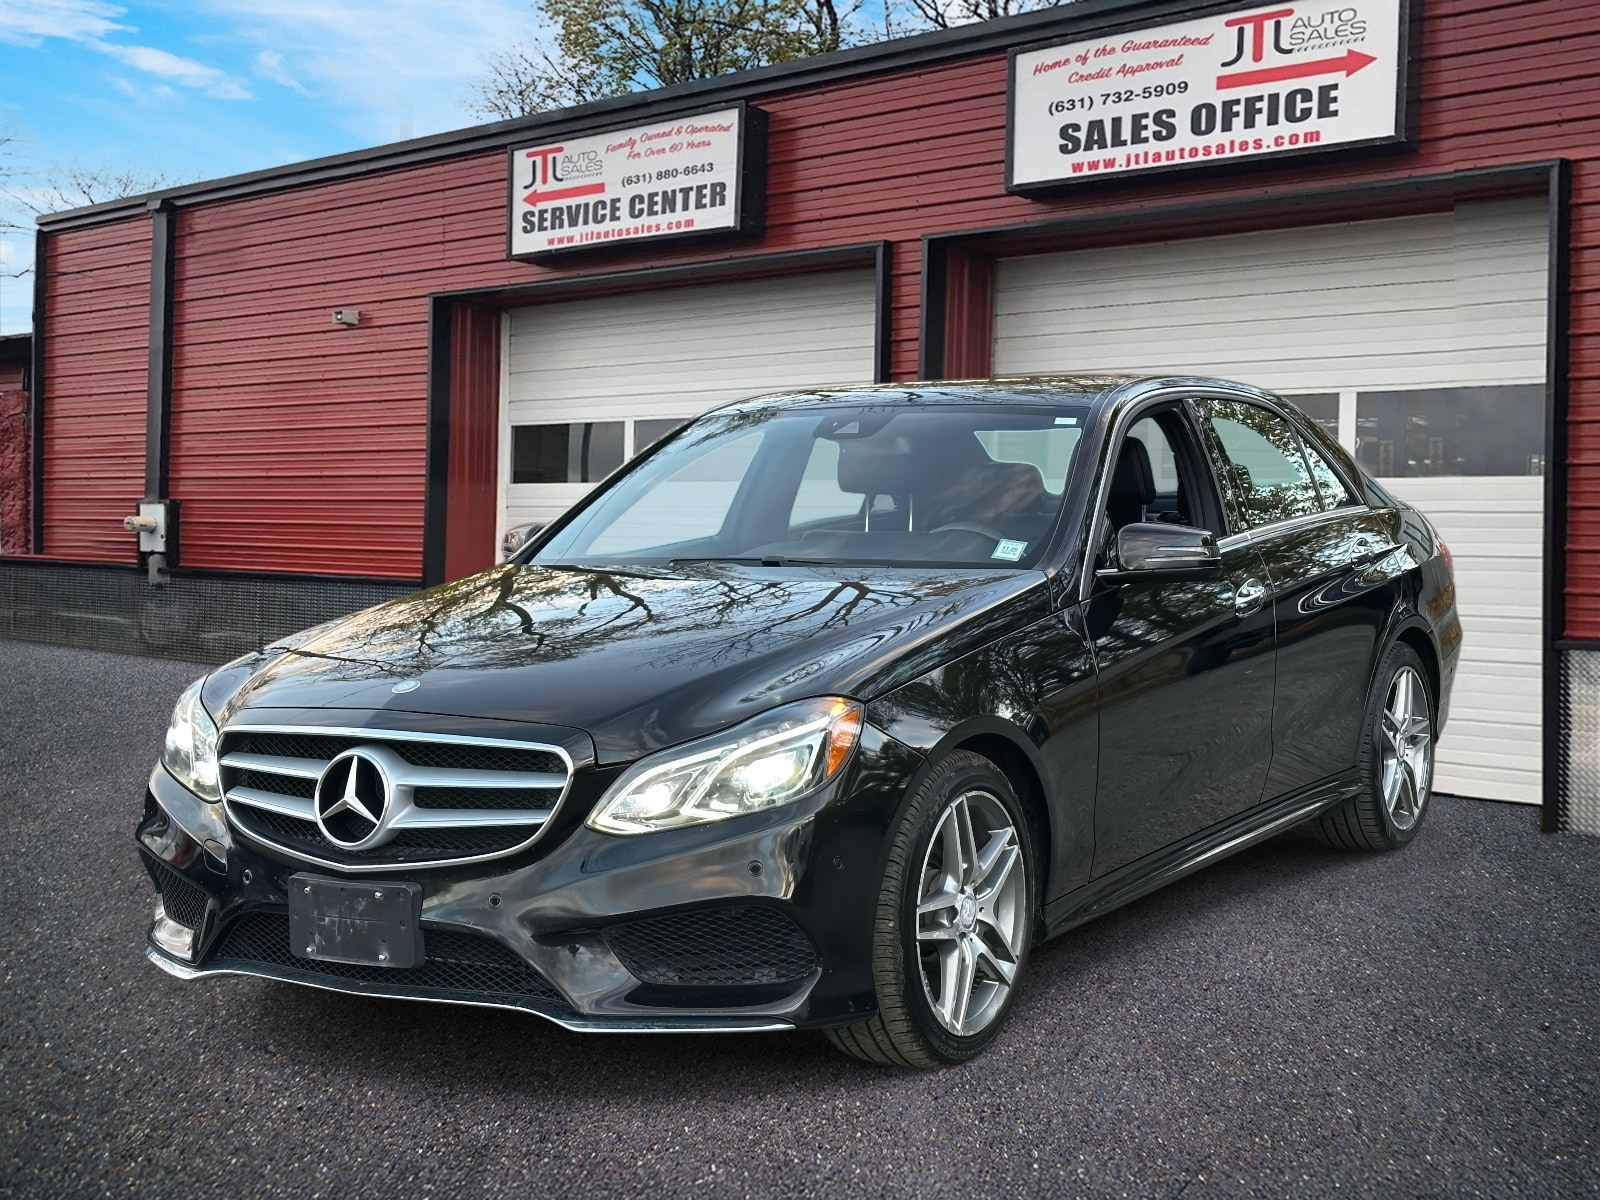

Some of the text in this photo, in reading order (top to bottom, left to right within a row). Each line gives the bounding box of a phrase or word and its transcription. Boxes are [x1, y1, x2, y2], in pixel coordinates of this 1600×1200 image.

[1289, 20, 1367, 46] SALES
[1290, 8, 1357, 32] AUTO
[1033, 33, 1215, 76] Home of the Guaranteed
[1068, 54, 1185, 84] Credit Approval
[1048, 80, 1189, 116] (631) 732-5909
[1059, 83, 1339, 155] SALES OFFICE
[605, 123, 734, 154] Family Owned & Operated
[626, 139, 712, 161] For Over 60 Years
[1071, 130, 1321, 173] www.jtlautosales.com
[560, 160, 604, 176] SALES
[561, 150, 598, 166] AUTO
[621, 162, 714, 188] (631) 880-6643
[522, 181, 727, 234] SERVICE CENTER
[547, 218, 695, 247] www.jtlautosales.com
